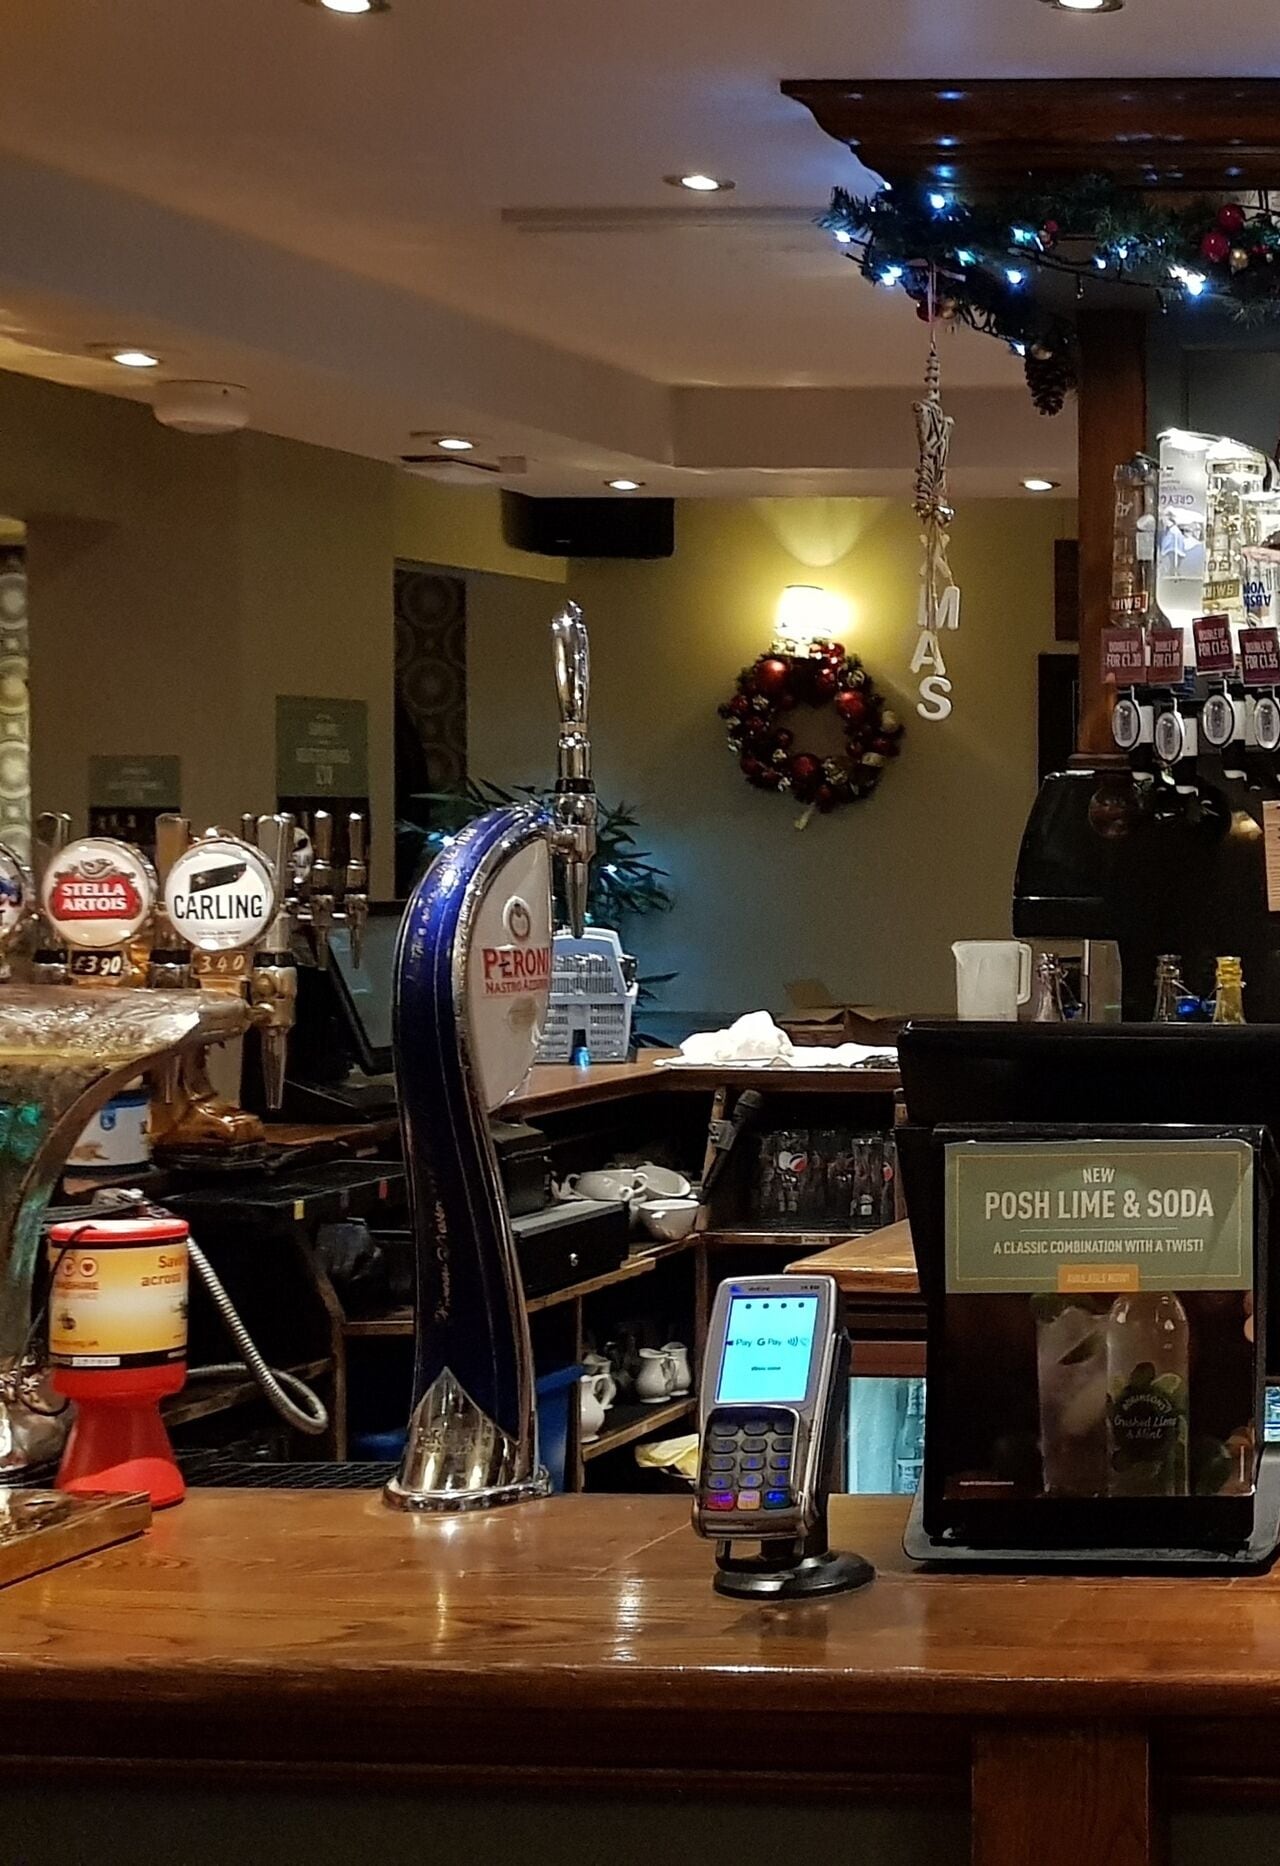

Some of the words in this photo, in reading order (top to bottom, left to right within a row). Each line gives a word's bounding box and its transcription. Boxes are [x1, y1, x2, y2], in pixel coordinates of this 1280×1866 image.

[62, 882, 126, 898] STELLA
[62, 897, 128, 911] ARTOIS
[174, 895, 263, 921] CARLING
[482, 947, 549, 979] PERONI
[1082, 1168, 1115, 1184] NEW
[985, 1190, 1050, 1220] POSH
[1057, 1190, 1115, 1219] LIME
[1123, 1189, 1141, 1218] &
[1147, 1188, 1214, 1218] SODA
[993, 1242, 1002, 1254] A
[1003, 1241, 1048, 1254] CLASSIC
[1050, 1239, 1123, 1254] COMBINATION
[1124, 1239, 1153, 1253] WITH
[1155, 1239, 1165, 1252] A
[1165, 1238, 1204, 1252] TWIST!
